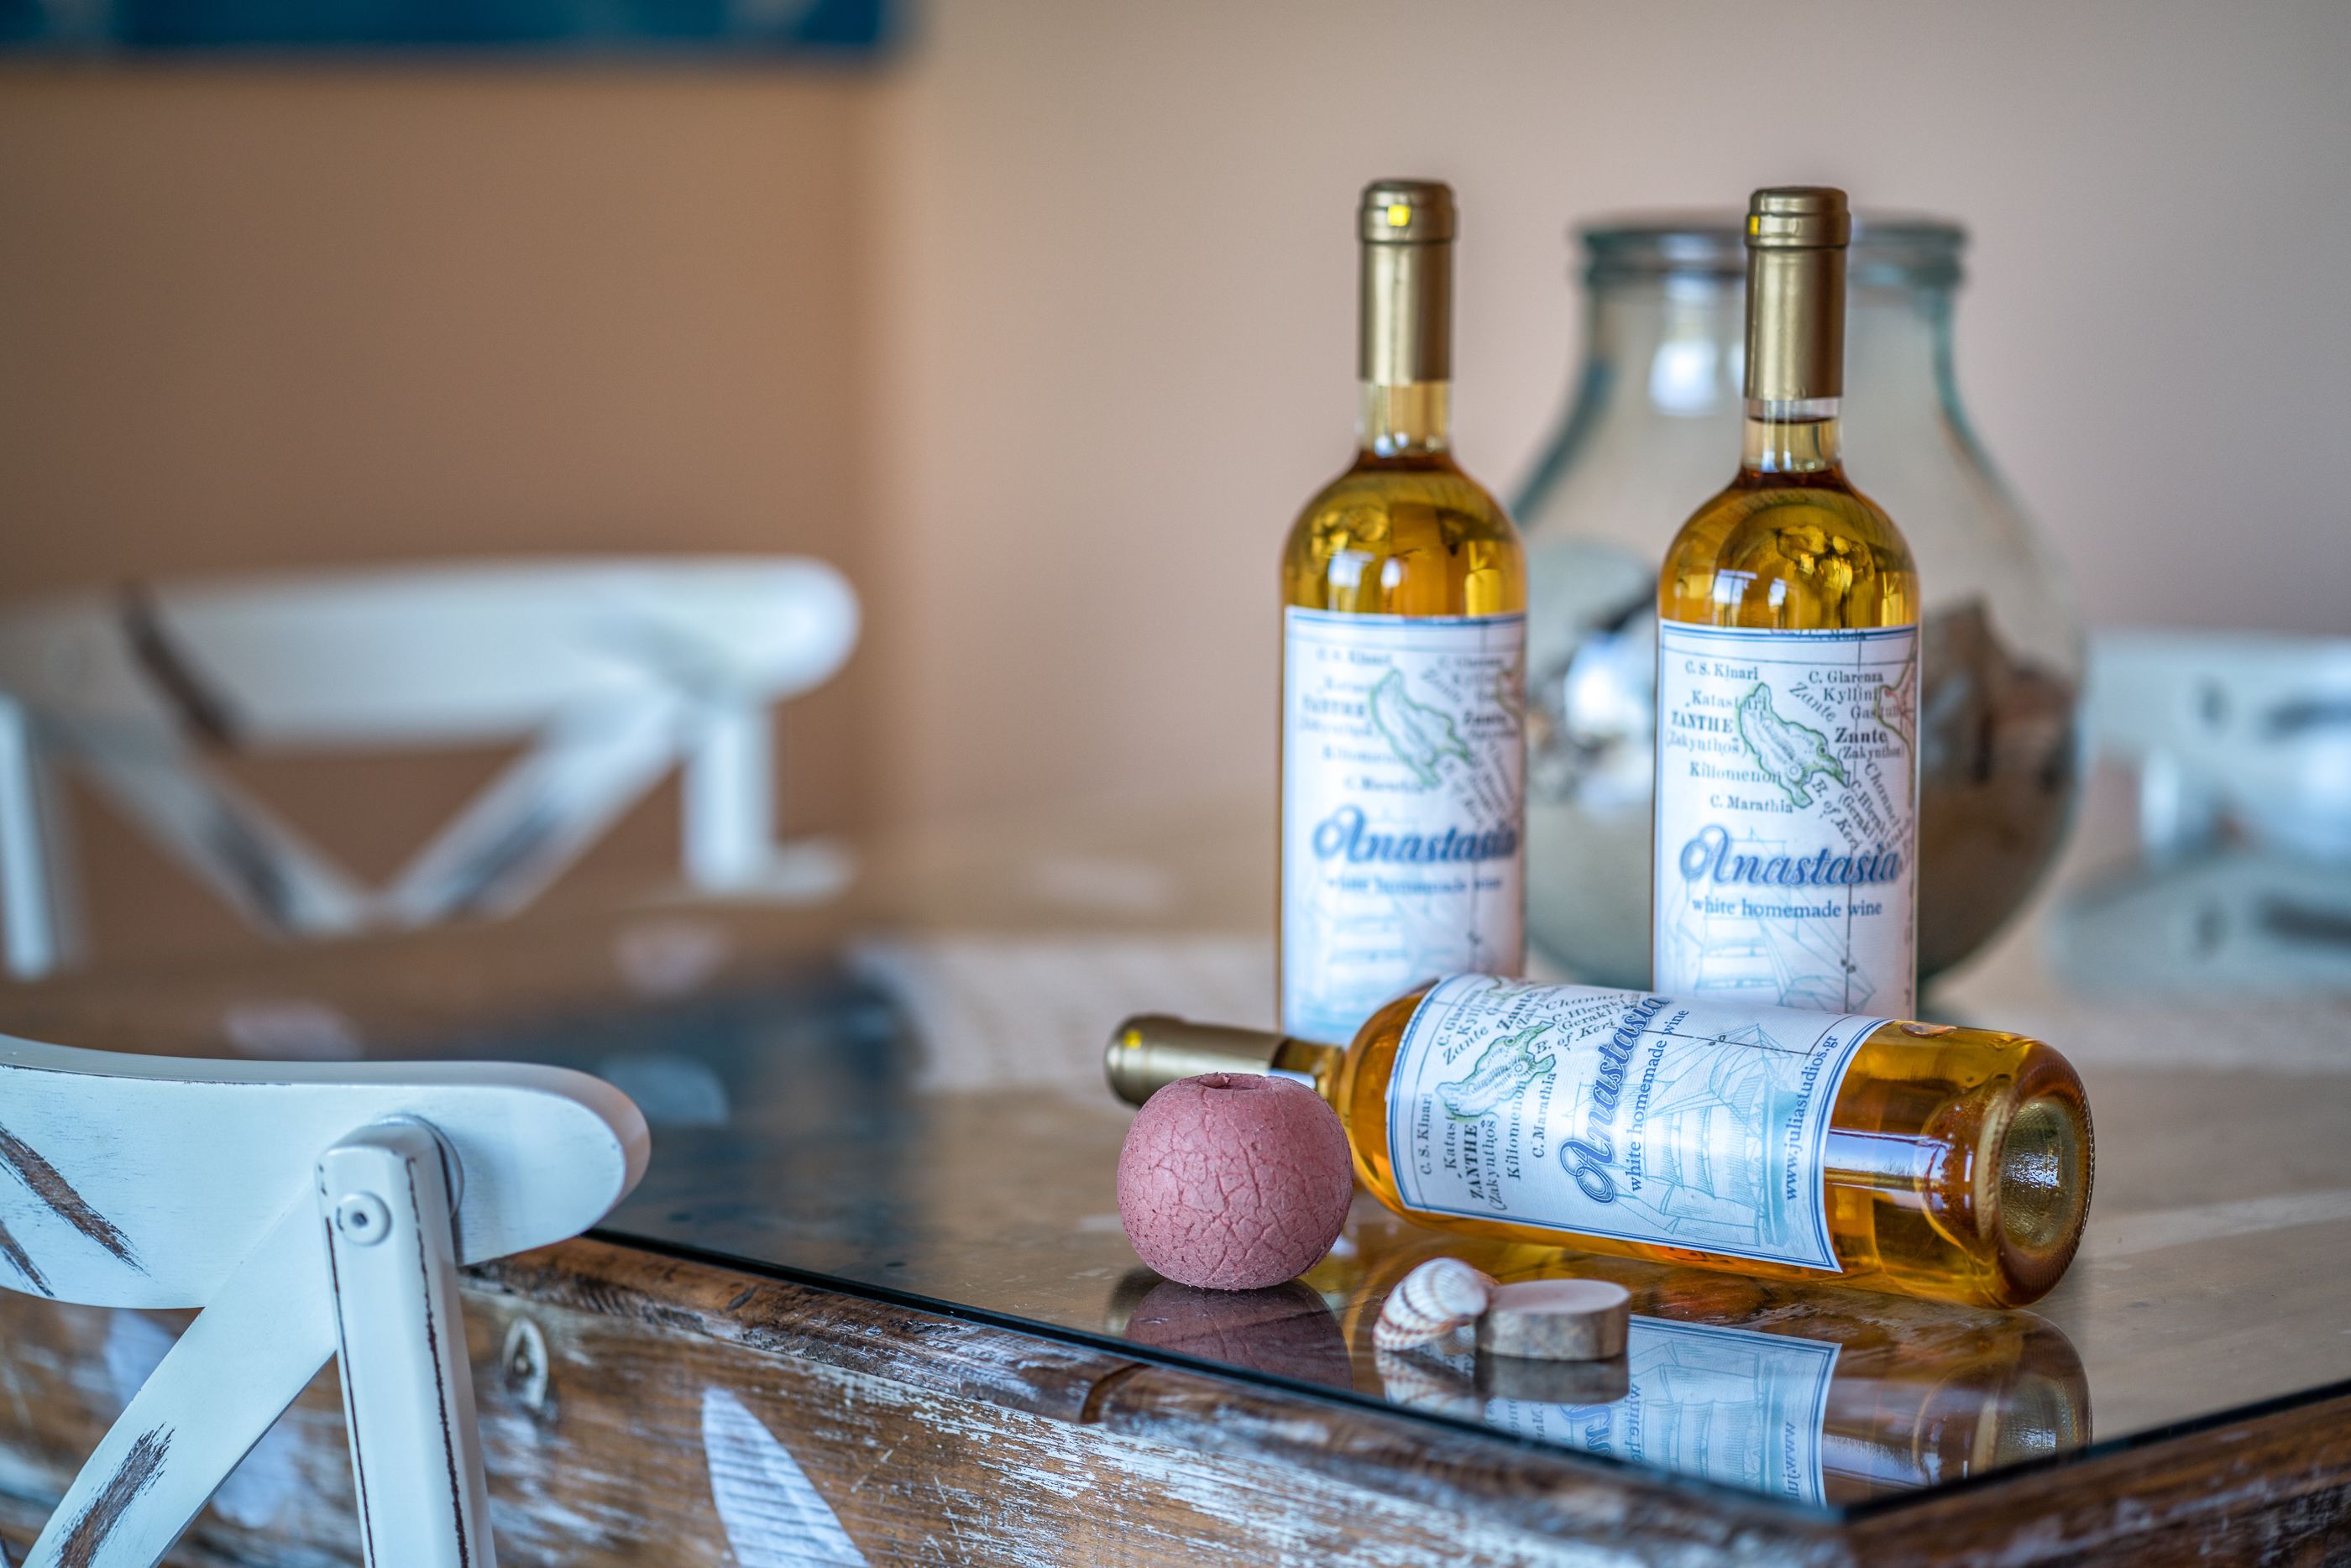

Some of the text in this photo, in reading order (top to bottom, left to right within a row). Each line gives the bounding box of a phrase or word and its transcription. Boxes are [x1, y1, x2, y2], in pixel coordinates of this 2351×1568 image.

[1809, 671, 1823, 684] C.
[1672, 711, 1734, 734] ZANTHE
[1788, 682, 1836, 723] Zante
[1835, 727, 1888, 744] Zante
[1679, 824, 1900, 885] Anastasia
[1693, 895, 1883, 919] white homemade wine
[1496, 991, 1538, 1031] Zante
[1546, 993, 1625, 1011] Channel
[1535, 1018, 1616, 1054] B. of Keri
[1659, 1009, 1690, 1037] wine
[1443, 1025, 1490, 1066] Zante
[1559, 996, 1673, 1204] Anastasia
[1626, 1038, 1668, 1136] homemade
[1785, 1034, 1839, 1201] www.juliastudios.gr
[1463, 1123, 1485, 1200] ZANTHE
[1625, 1140, 1643, 1193] white
